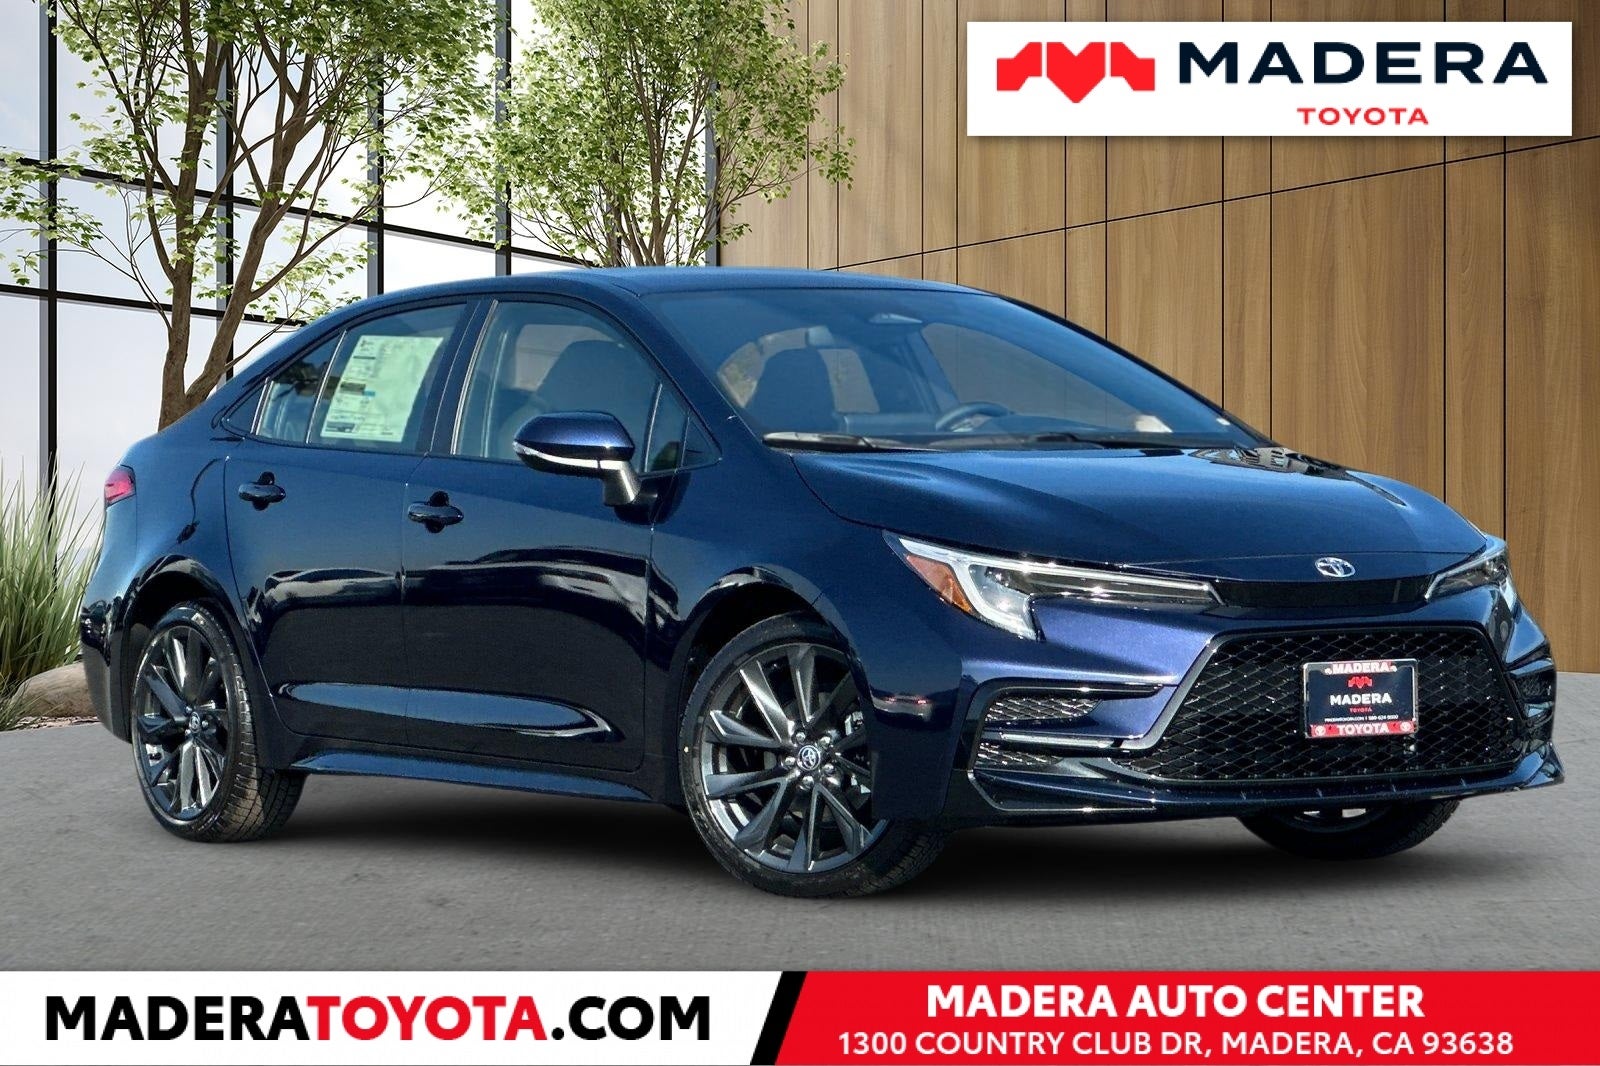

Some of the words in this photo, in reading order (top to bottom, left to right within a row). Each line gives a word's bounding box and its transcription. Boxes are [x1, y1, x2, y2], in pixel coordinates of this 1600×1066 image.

[1332, 661, 1390, 674] MADERA
[1330, 692, 1392, 706] MADERA
[1337, 723, 1390, 736] TOYOTA
